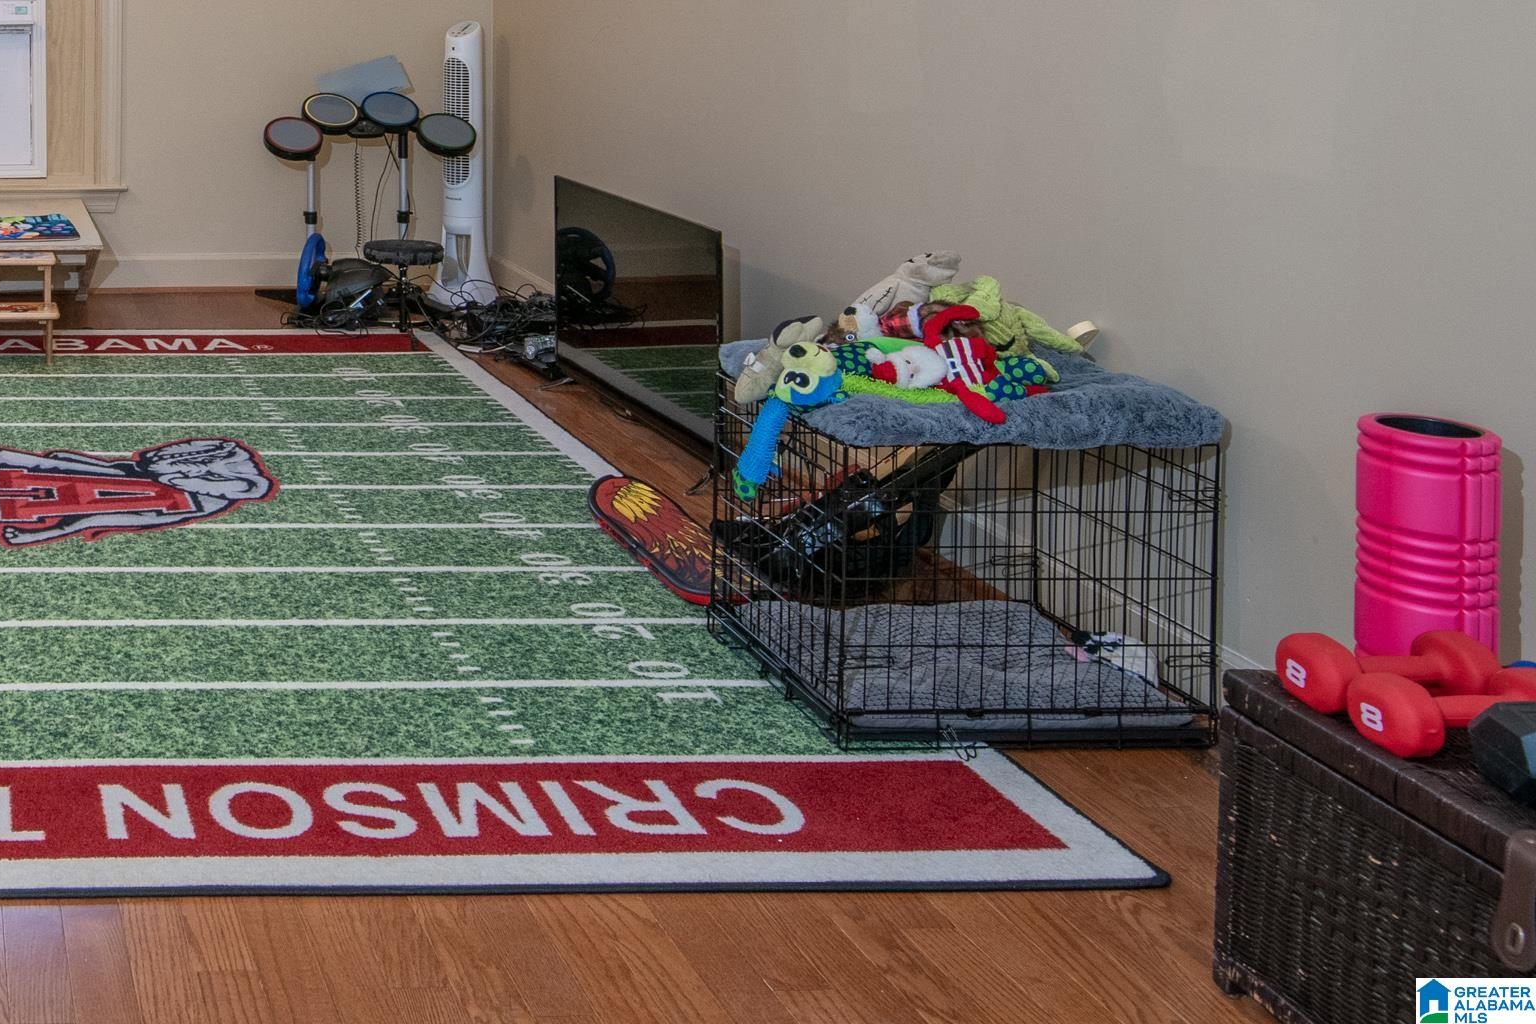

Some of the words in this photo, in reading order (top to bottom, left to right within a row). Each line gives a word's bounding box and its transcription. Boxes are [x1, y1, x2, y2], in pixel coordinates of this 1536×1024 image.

[1285, 658, 1307, 689] 8
[1360, 702, 1384, 732] 8
[98, 778, 806, 841] CRIMSON
